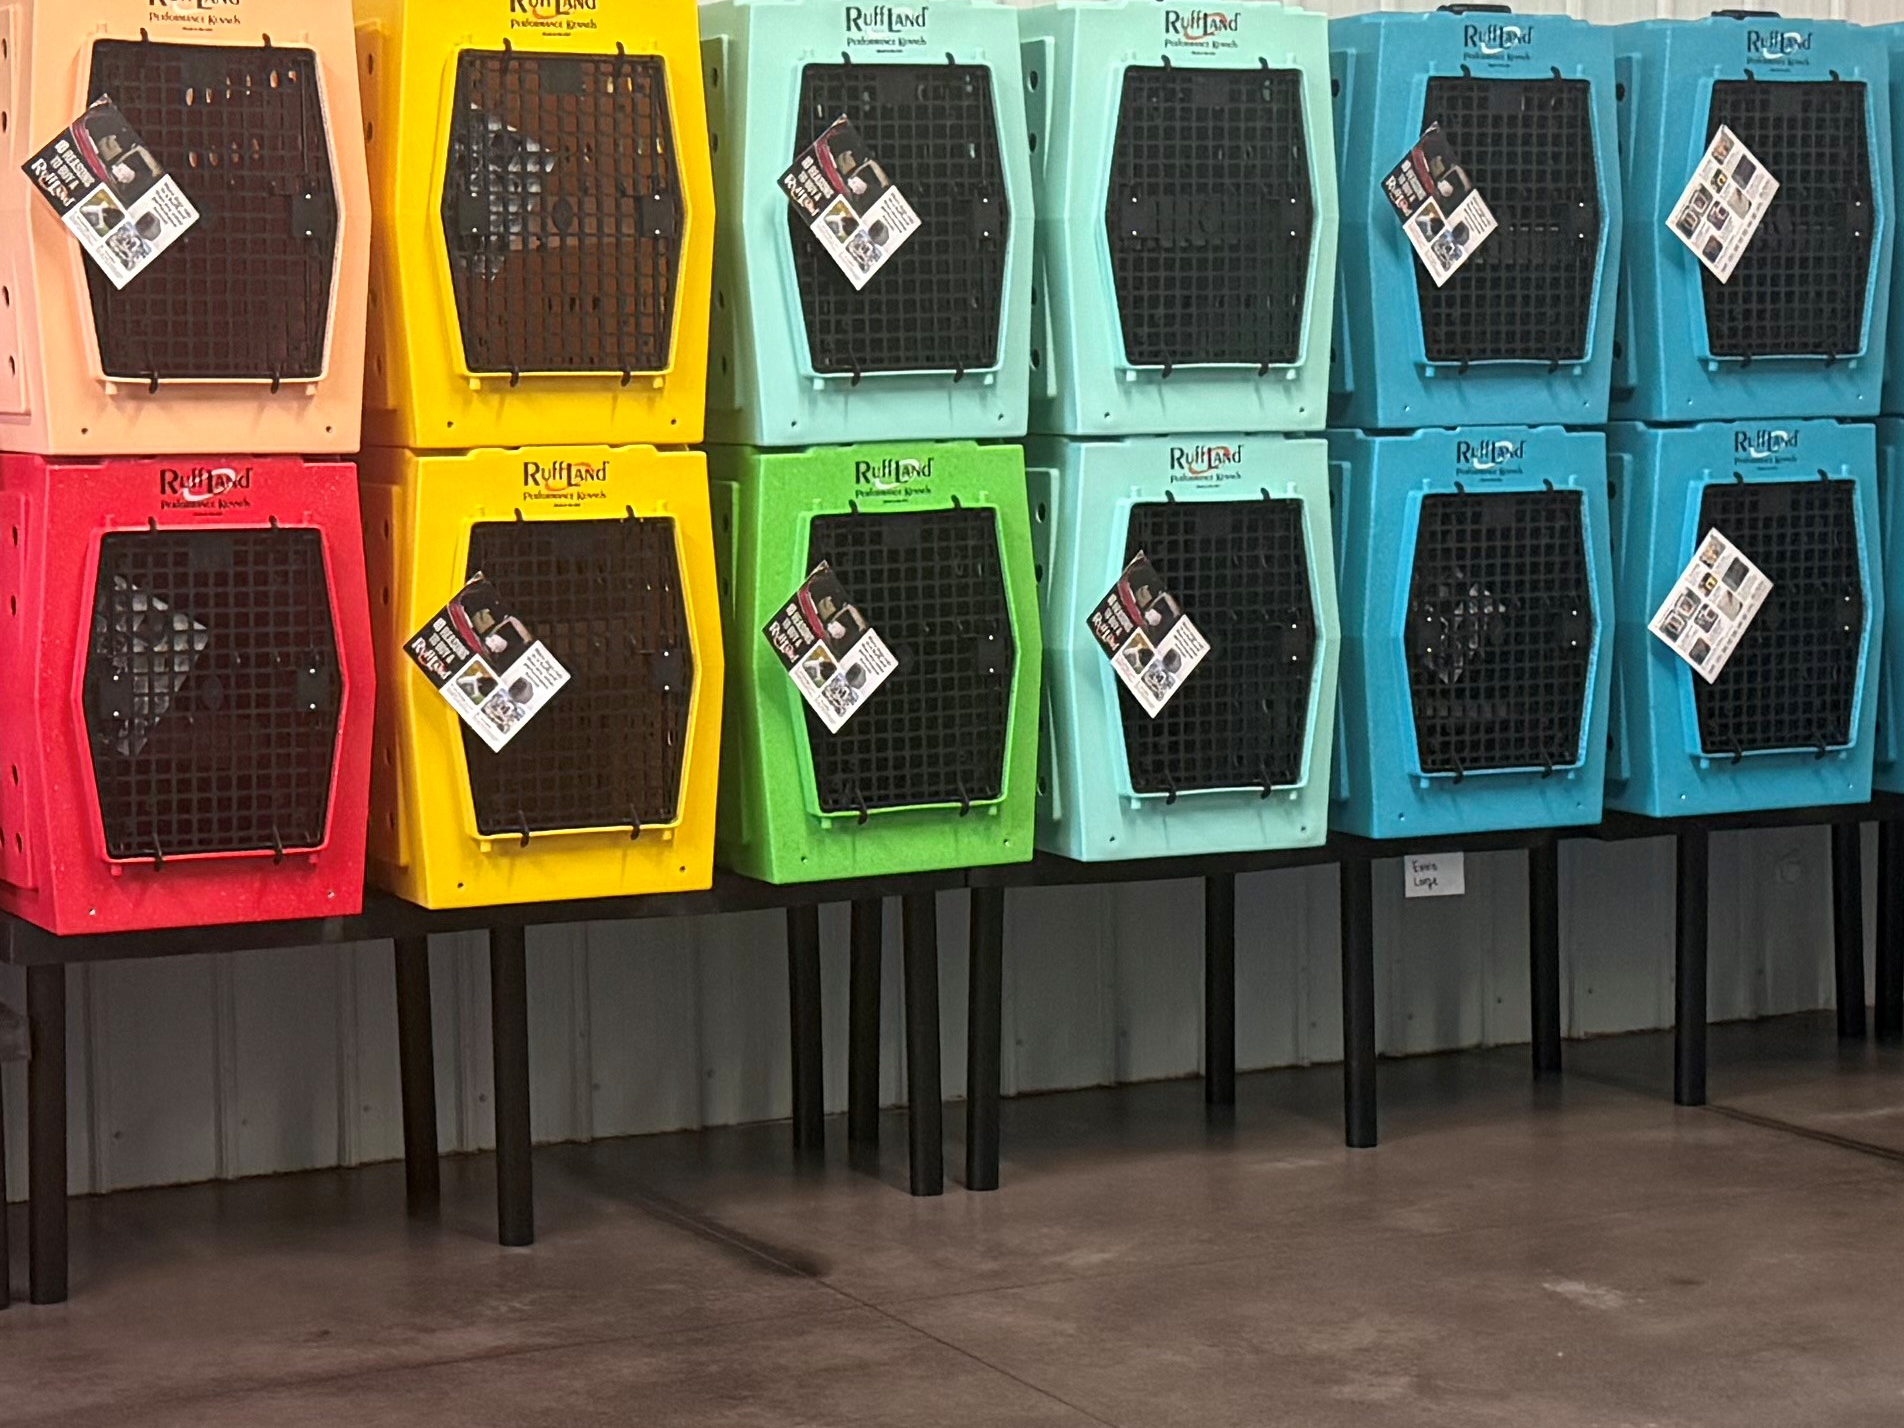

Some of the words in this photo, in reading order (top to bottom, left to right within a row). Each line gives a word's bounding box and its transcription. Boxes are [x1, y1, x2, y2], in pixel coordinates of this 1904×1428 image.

[846, 5, 929, 33] RuffLand
[1165, 10, 1241, 36] RuffLand
[53, 138, 70, 154] 10
[49, 155, 63, 170] TO
[56, 163, 75, 184] BUY
[68, 179, 80, 190] A
[61, 148, 95, 188] REASONS
[813, 190, 823, 202] A
[1170, 444, 1244, 470] RuffLand
[160, 468, 253, 496] RuffLand
[523, 460, 609, 487] RuffLand
[855, 457, 934, 484] RuffLand
[794, 636, 803, 647] A
[444, 652, 456, 664] A
